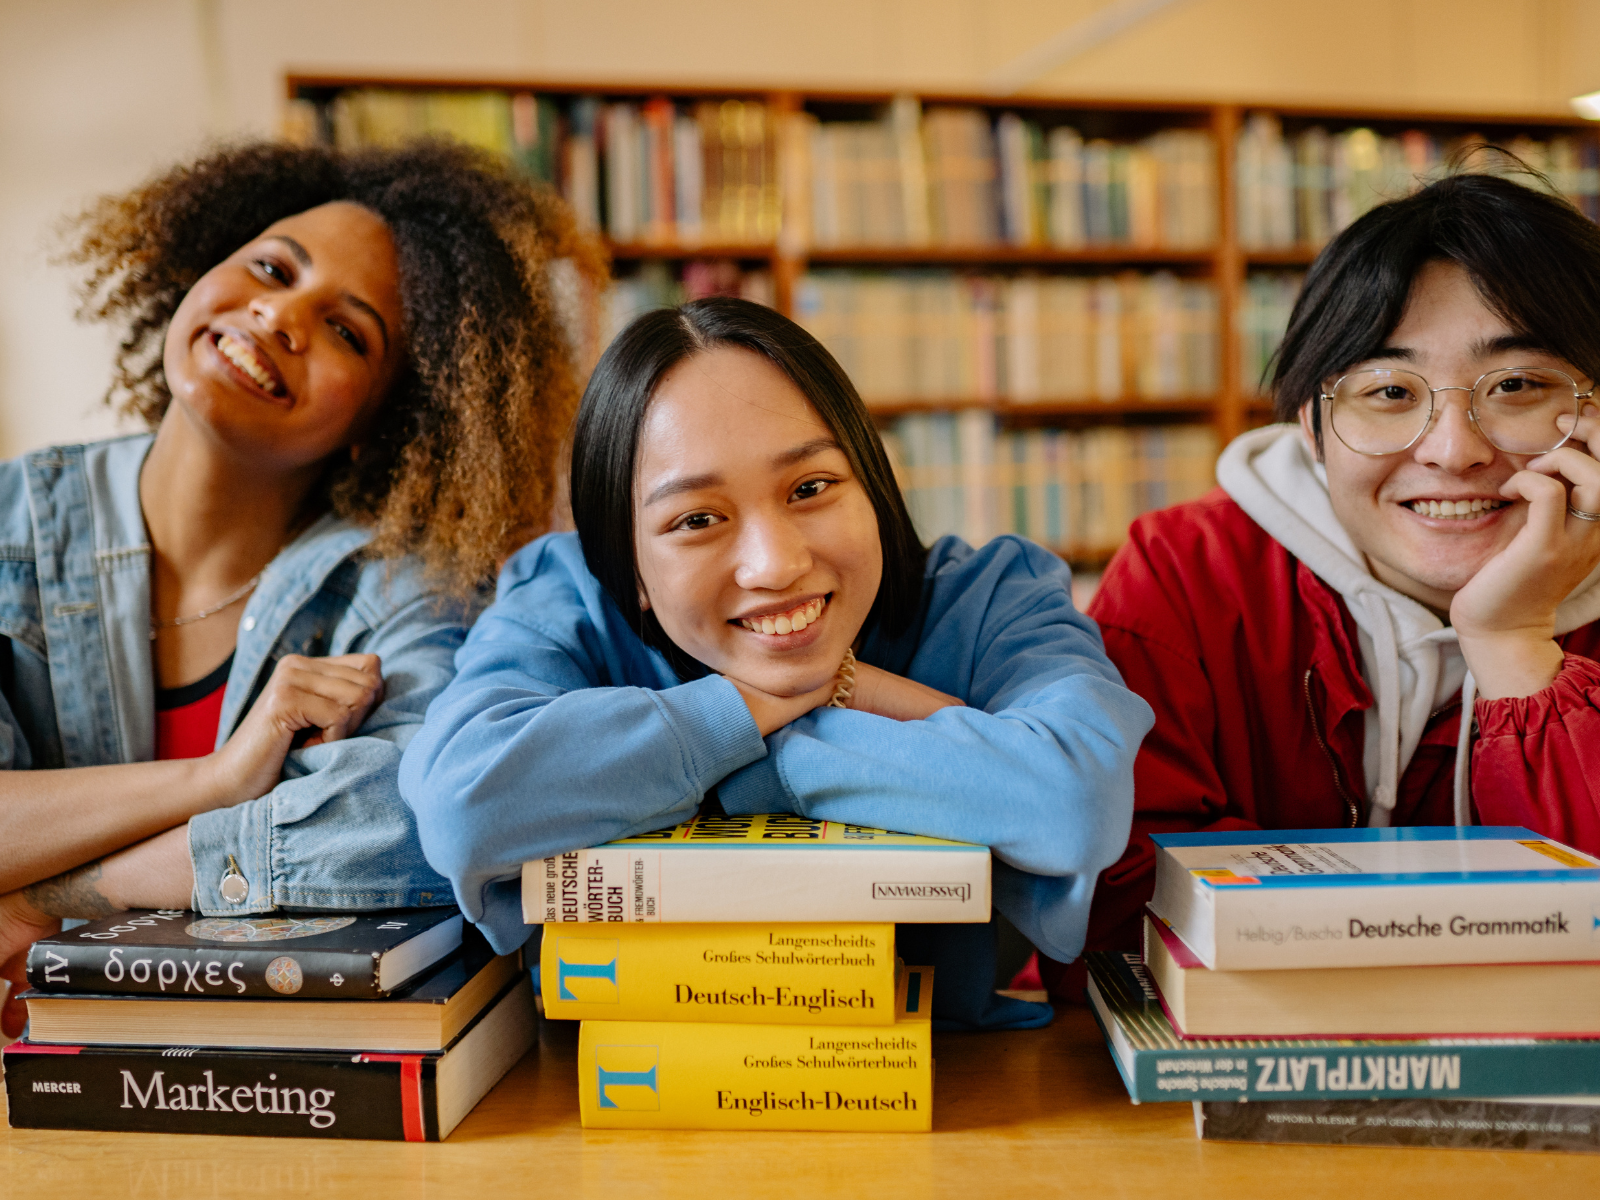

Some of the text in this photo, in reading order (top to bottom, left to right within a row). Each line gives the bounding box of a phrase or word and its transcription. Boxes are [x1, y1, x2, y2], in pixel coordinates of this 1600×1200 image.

[543, 857, 559, 923] Das neue groß
[562, 852, 579, 923] DEUTSCHE
[583, 859, 604, 923] WÖRTER-
[607, 886, 624, 923] BUCH
[646, 896, 656, 916] BUCH
[1349, 912, 1571, 939] Deutsche Grammatik
[769, 933, 876, 951] Langenscheidts
[702, 949, 876, 967] Großes Schulwörterbuch
[674, 983, 875, 1014] Deutsch-Englisch
[809, 1036, 918, 1055] Langenscheidts
[743, 1055, 918, 1070] Großes Schulwörterbuch
[1156, 1058, 1248, 1074] in der Wirtschaft
[1255, 1055, 1461, 1092] MARKTPLATZ
[32, 1081, 82, 1094] MERCER
[1156, 1076, 1248, 1093] Deutsche Sprache
[119, 1069, 336, 1128] Marketing
[716, 1090, 918, 1117] Englisch-Deutsch
[1266, 1113, 1314, 1125] MEMORIA
[1315, 1114, 1357, 1126] SILESIAE
[1365, 1116, 1387, 1127] ZUM
